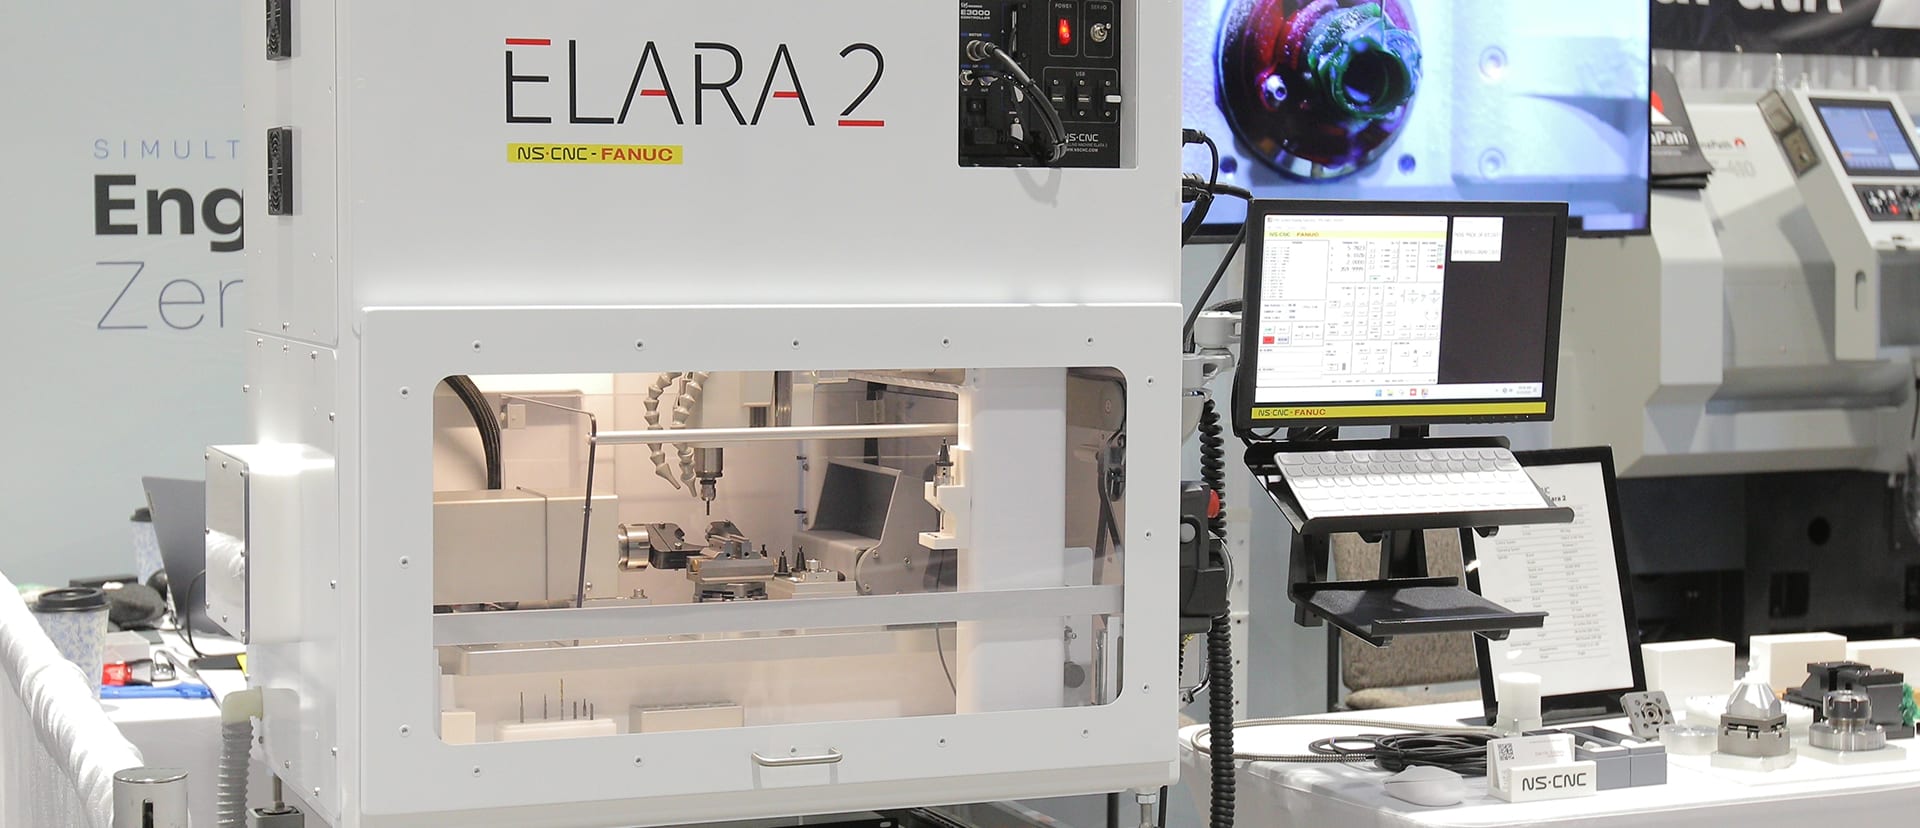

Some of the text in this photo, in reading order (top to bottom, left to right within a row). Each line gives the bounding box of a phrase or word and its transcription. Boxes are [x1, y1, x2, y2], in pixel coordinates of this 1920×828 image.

[505, 38, 885, 127] ELARA 2
[93, 138, 241, 160] SIMULT
[601, 148, 673, 161] FANUC
[93, 174, 244, 252] Eng
[95, 261, 244, 330] Zer
